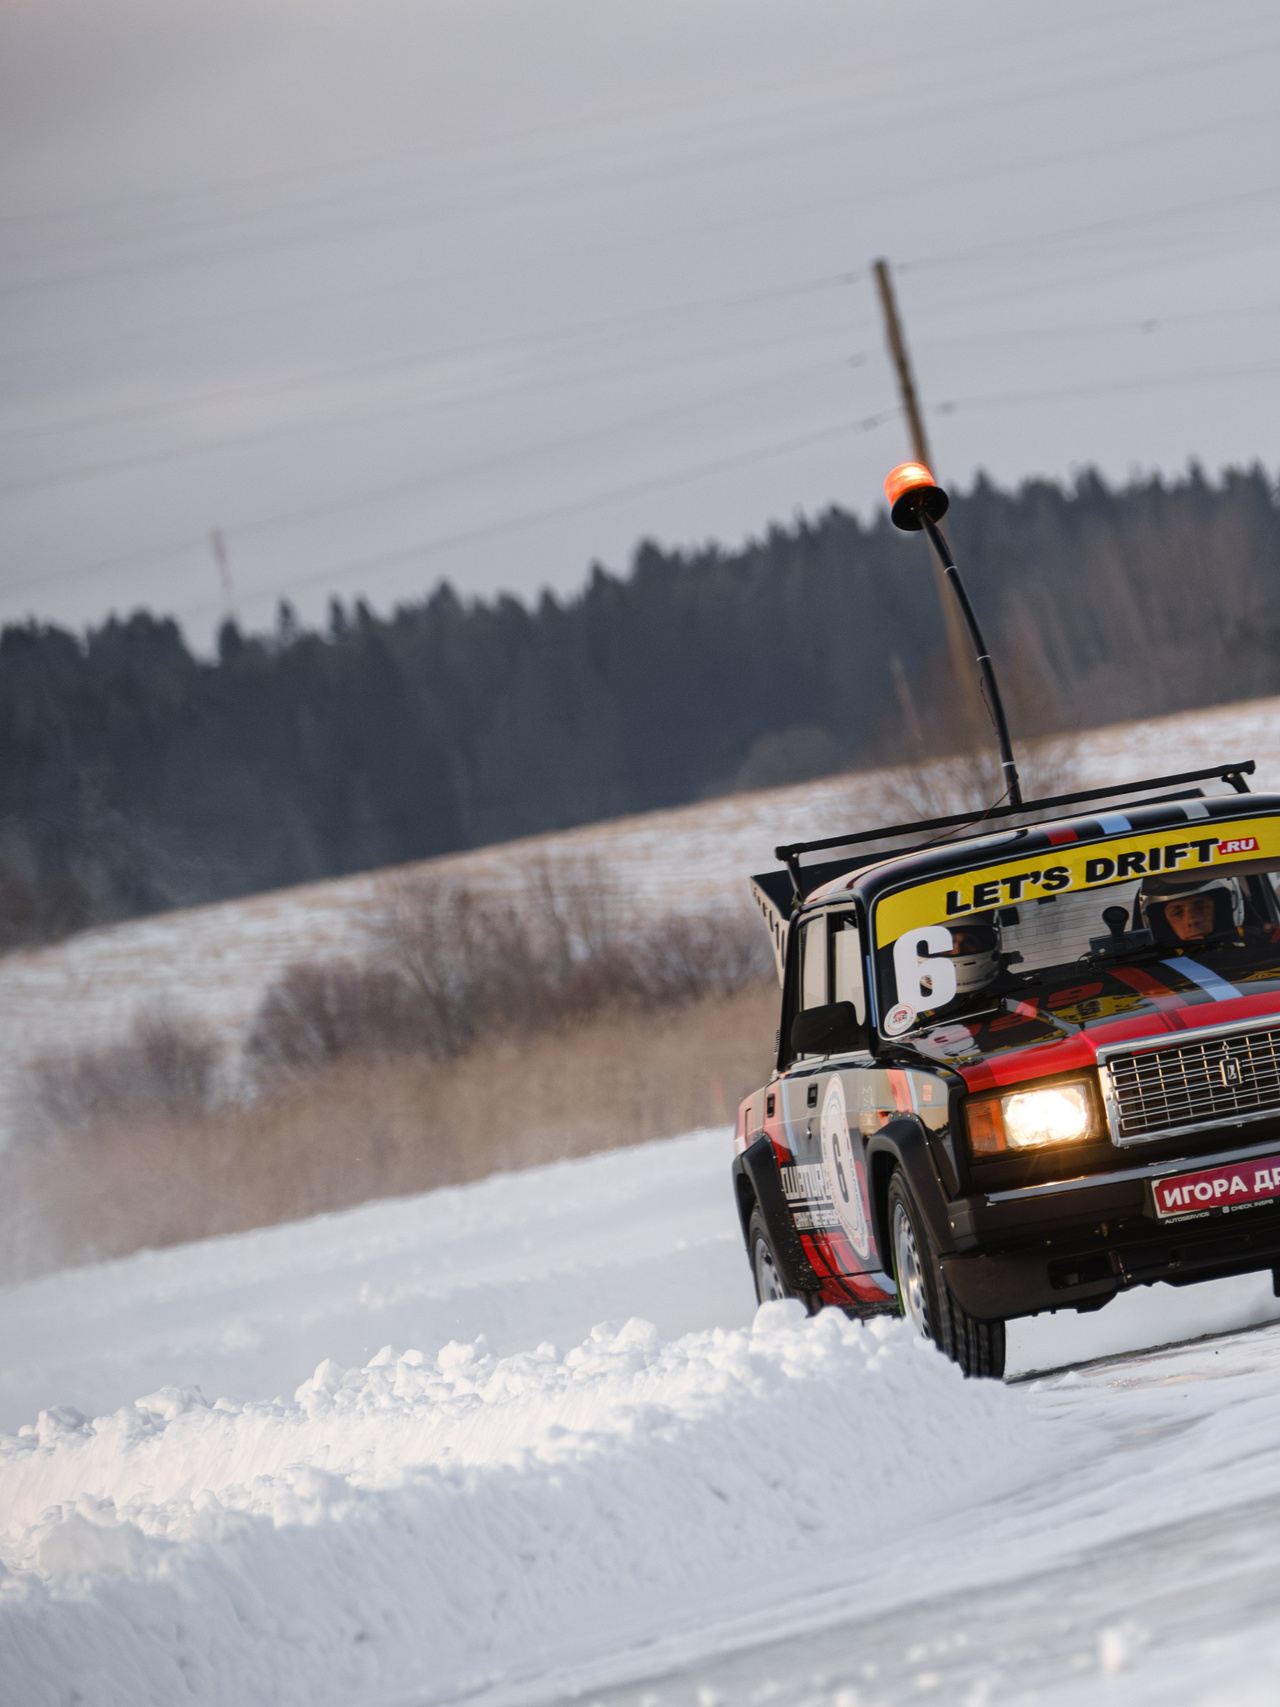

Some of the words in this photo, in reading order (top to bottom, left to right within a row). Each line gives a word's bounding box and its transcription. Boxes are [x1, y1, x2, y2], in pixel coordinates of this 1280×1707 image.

[945, 865, 1071, 917] LET'S
[893, 925, 957, 1013] 6
[832, 1132, 849, 1204] 6
[1163, 1175, 1248, 1208] ИГОРА
